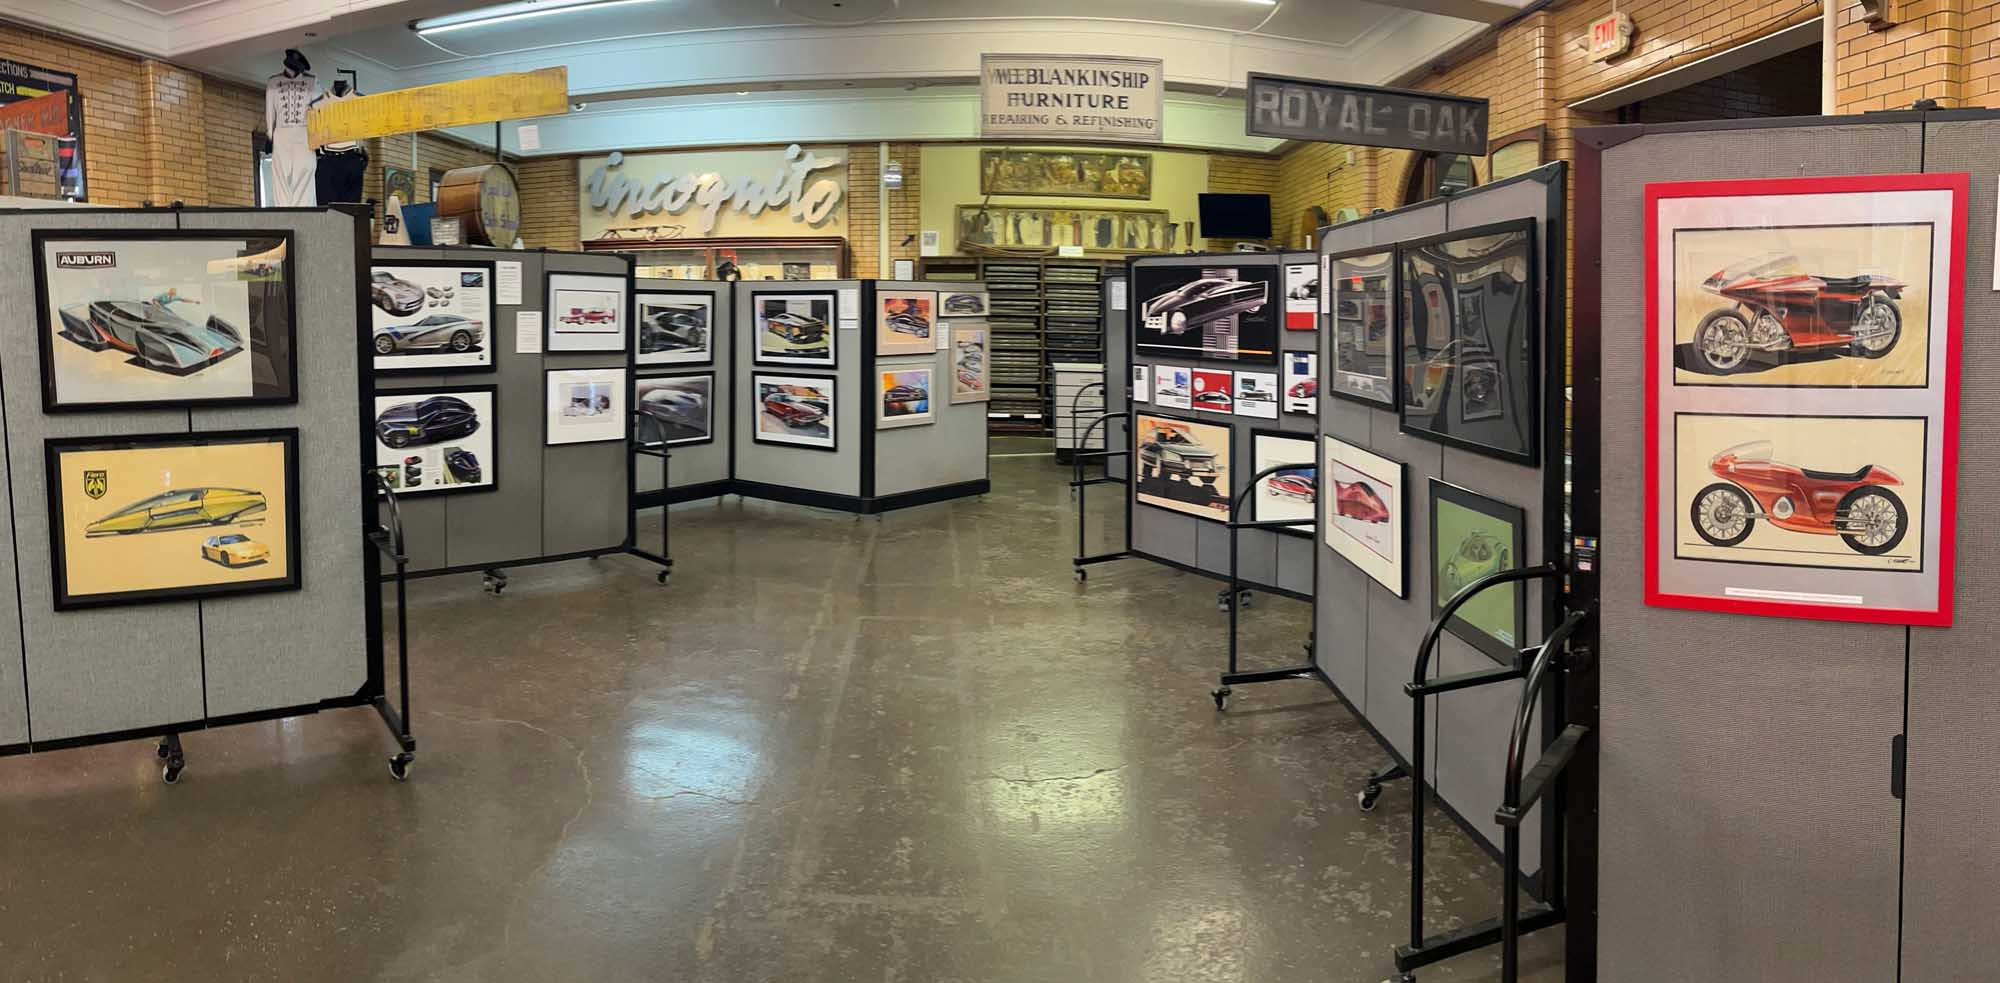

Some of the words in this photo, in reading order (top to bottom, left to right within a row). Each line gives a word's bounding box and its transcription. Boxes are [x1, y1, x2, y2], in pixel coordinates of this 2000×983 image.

[1594, 18, 1617, 49] EXIT
[1255, 84, 1388, 137] ROYAL
[1407, 102, 1482, 146] OAK
[585, 143, 842, 234] incognito
[60, 255, 112, 265] AUBURN
